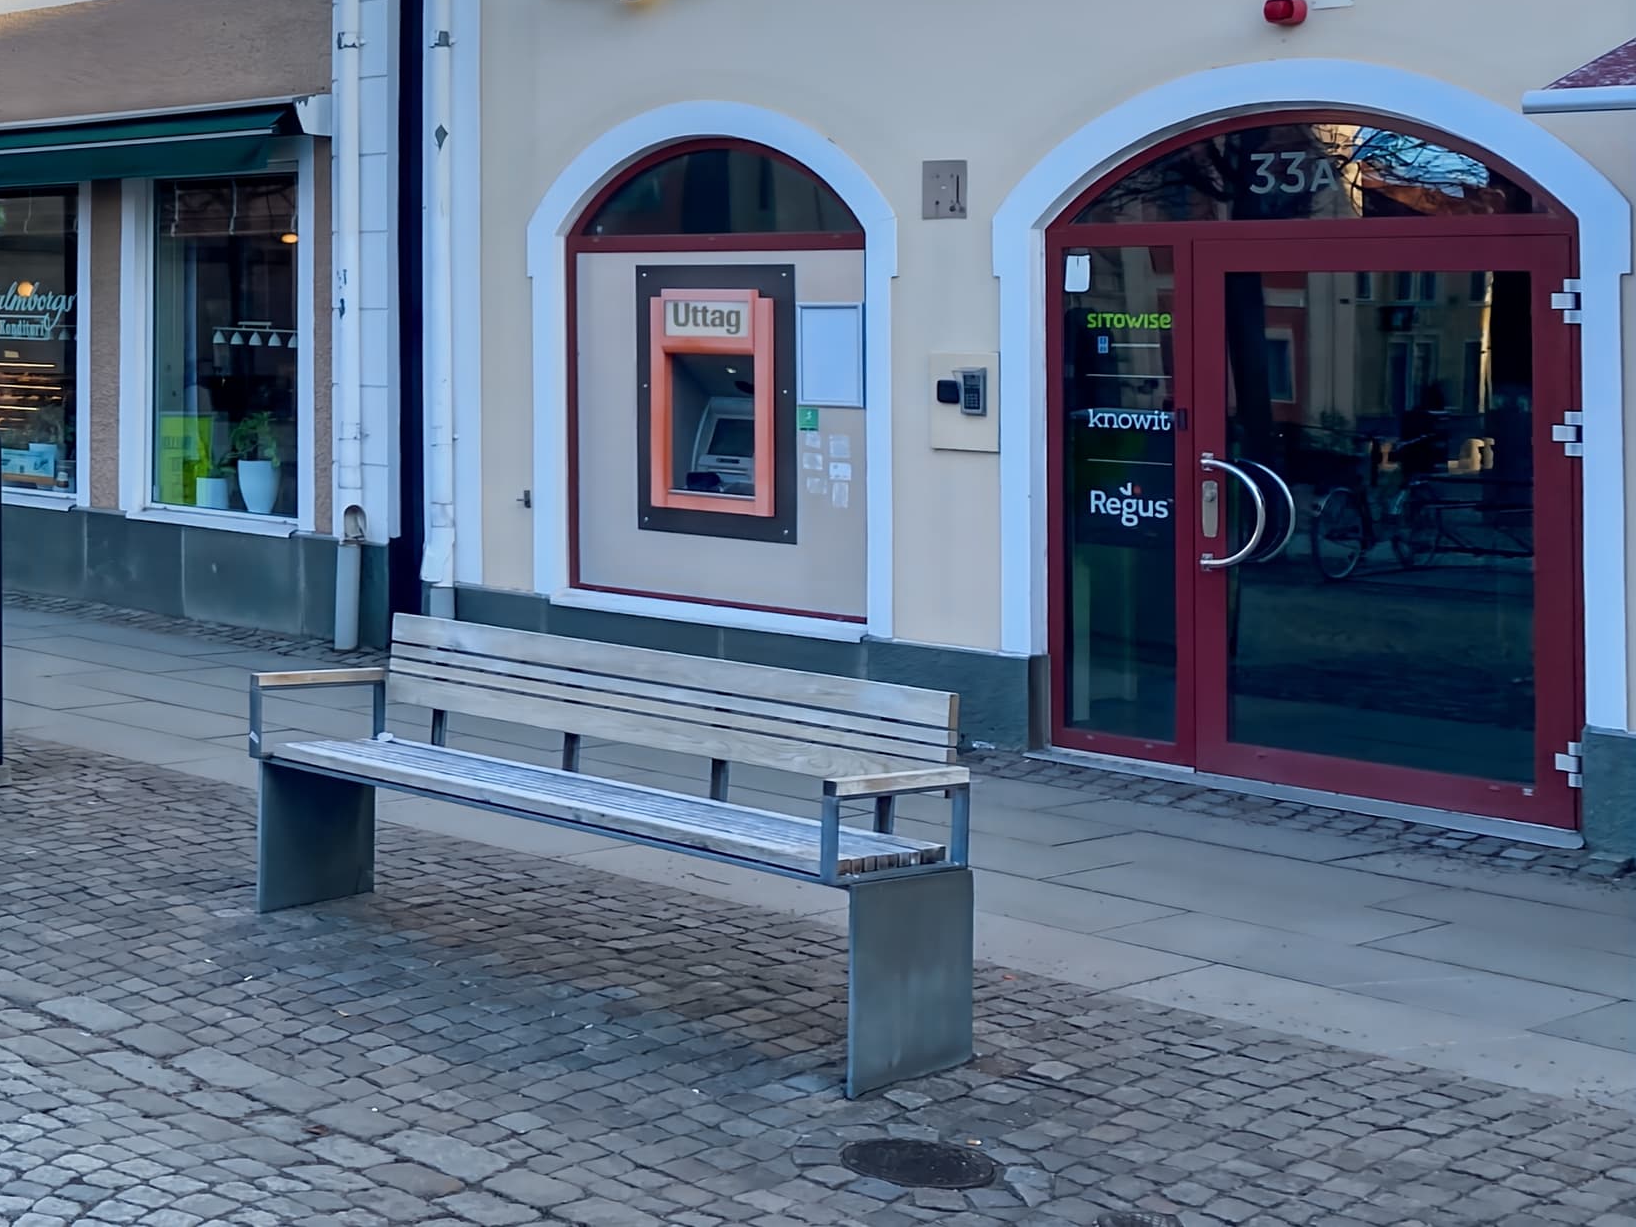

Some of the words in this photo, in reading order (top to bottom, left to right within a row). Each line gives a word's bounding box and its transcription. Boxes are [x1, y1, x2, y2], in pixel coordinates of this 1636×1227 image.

[1249, 151, 1339, 194] 33A
[672, 302, 742, 335] Uttag
[1087, 408, 1172, 431] knowit
[1090, 484, 1170, 527] Regus
